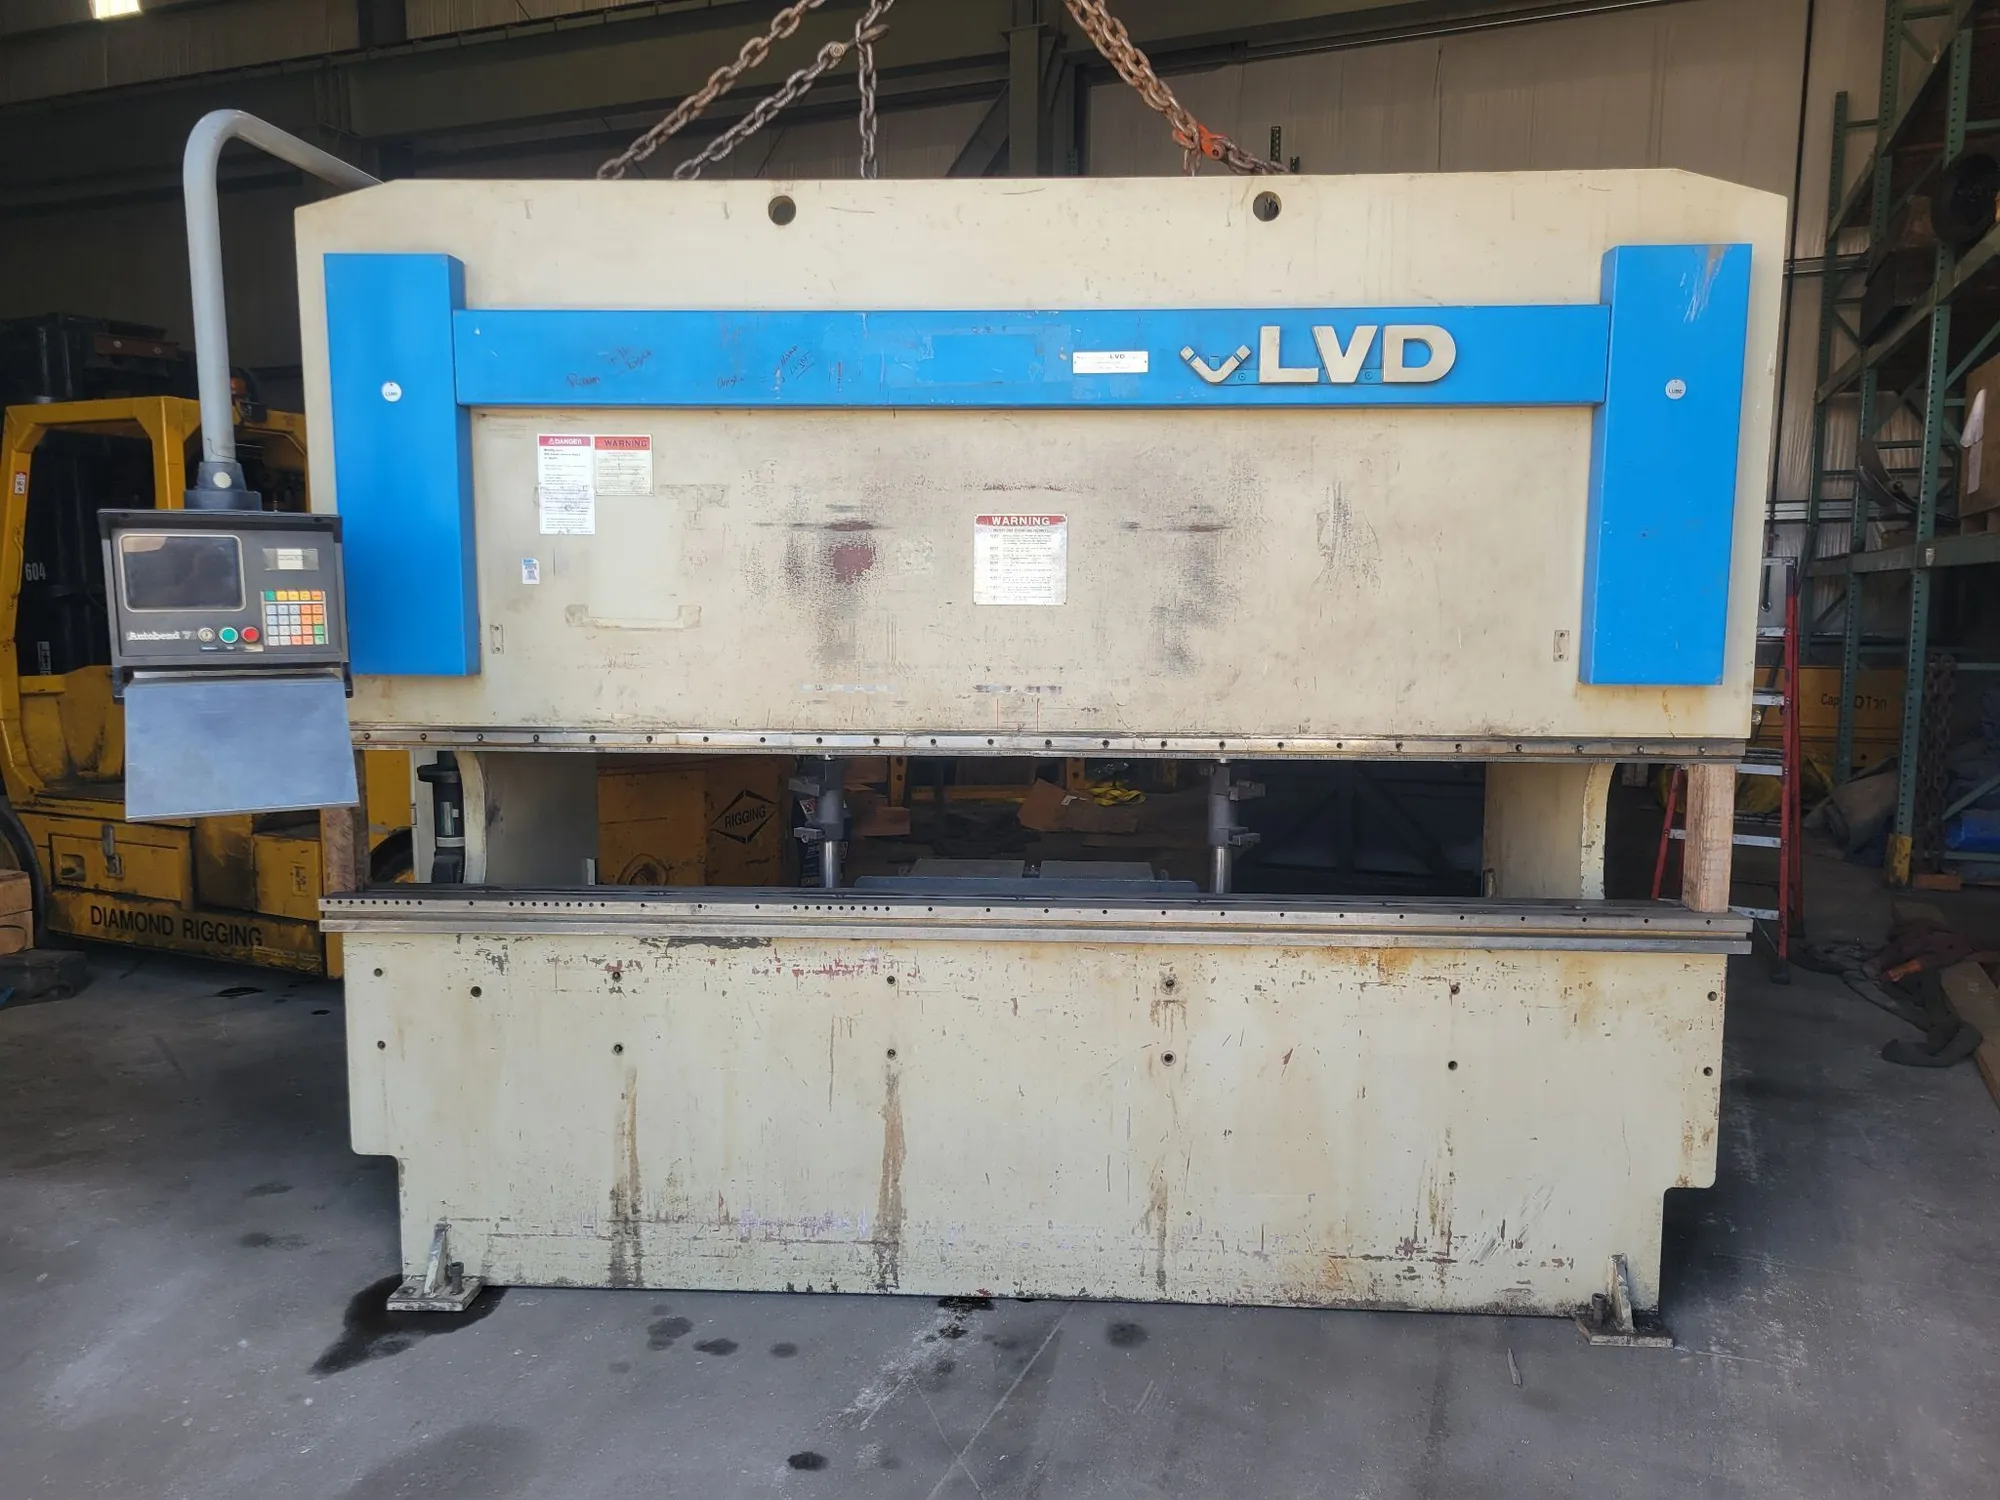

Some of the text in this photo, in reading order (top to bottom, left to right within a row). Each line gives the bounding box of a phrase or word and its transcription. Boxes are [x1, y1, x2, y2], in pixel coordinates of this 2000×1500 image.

[1259, 325, 1457, 384] LVD
[604, 439, 648, 447] WARNING
[991, 516, 1051, 526] WARNING
[25, 562, 47, 581] 604
[724, 805, 767, 828] RIGGING
[90, 905, 264, 947] DIAMOND RIGGING
